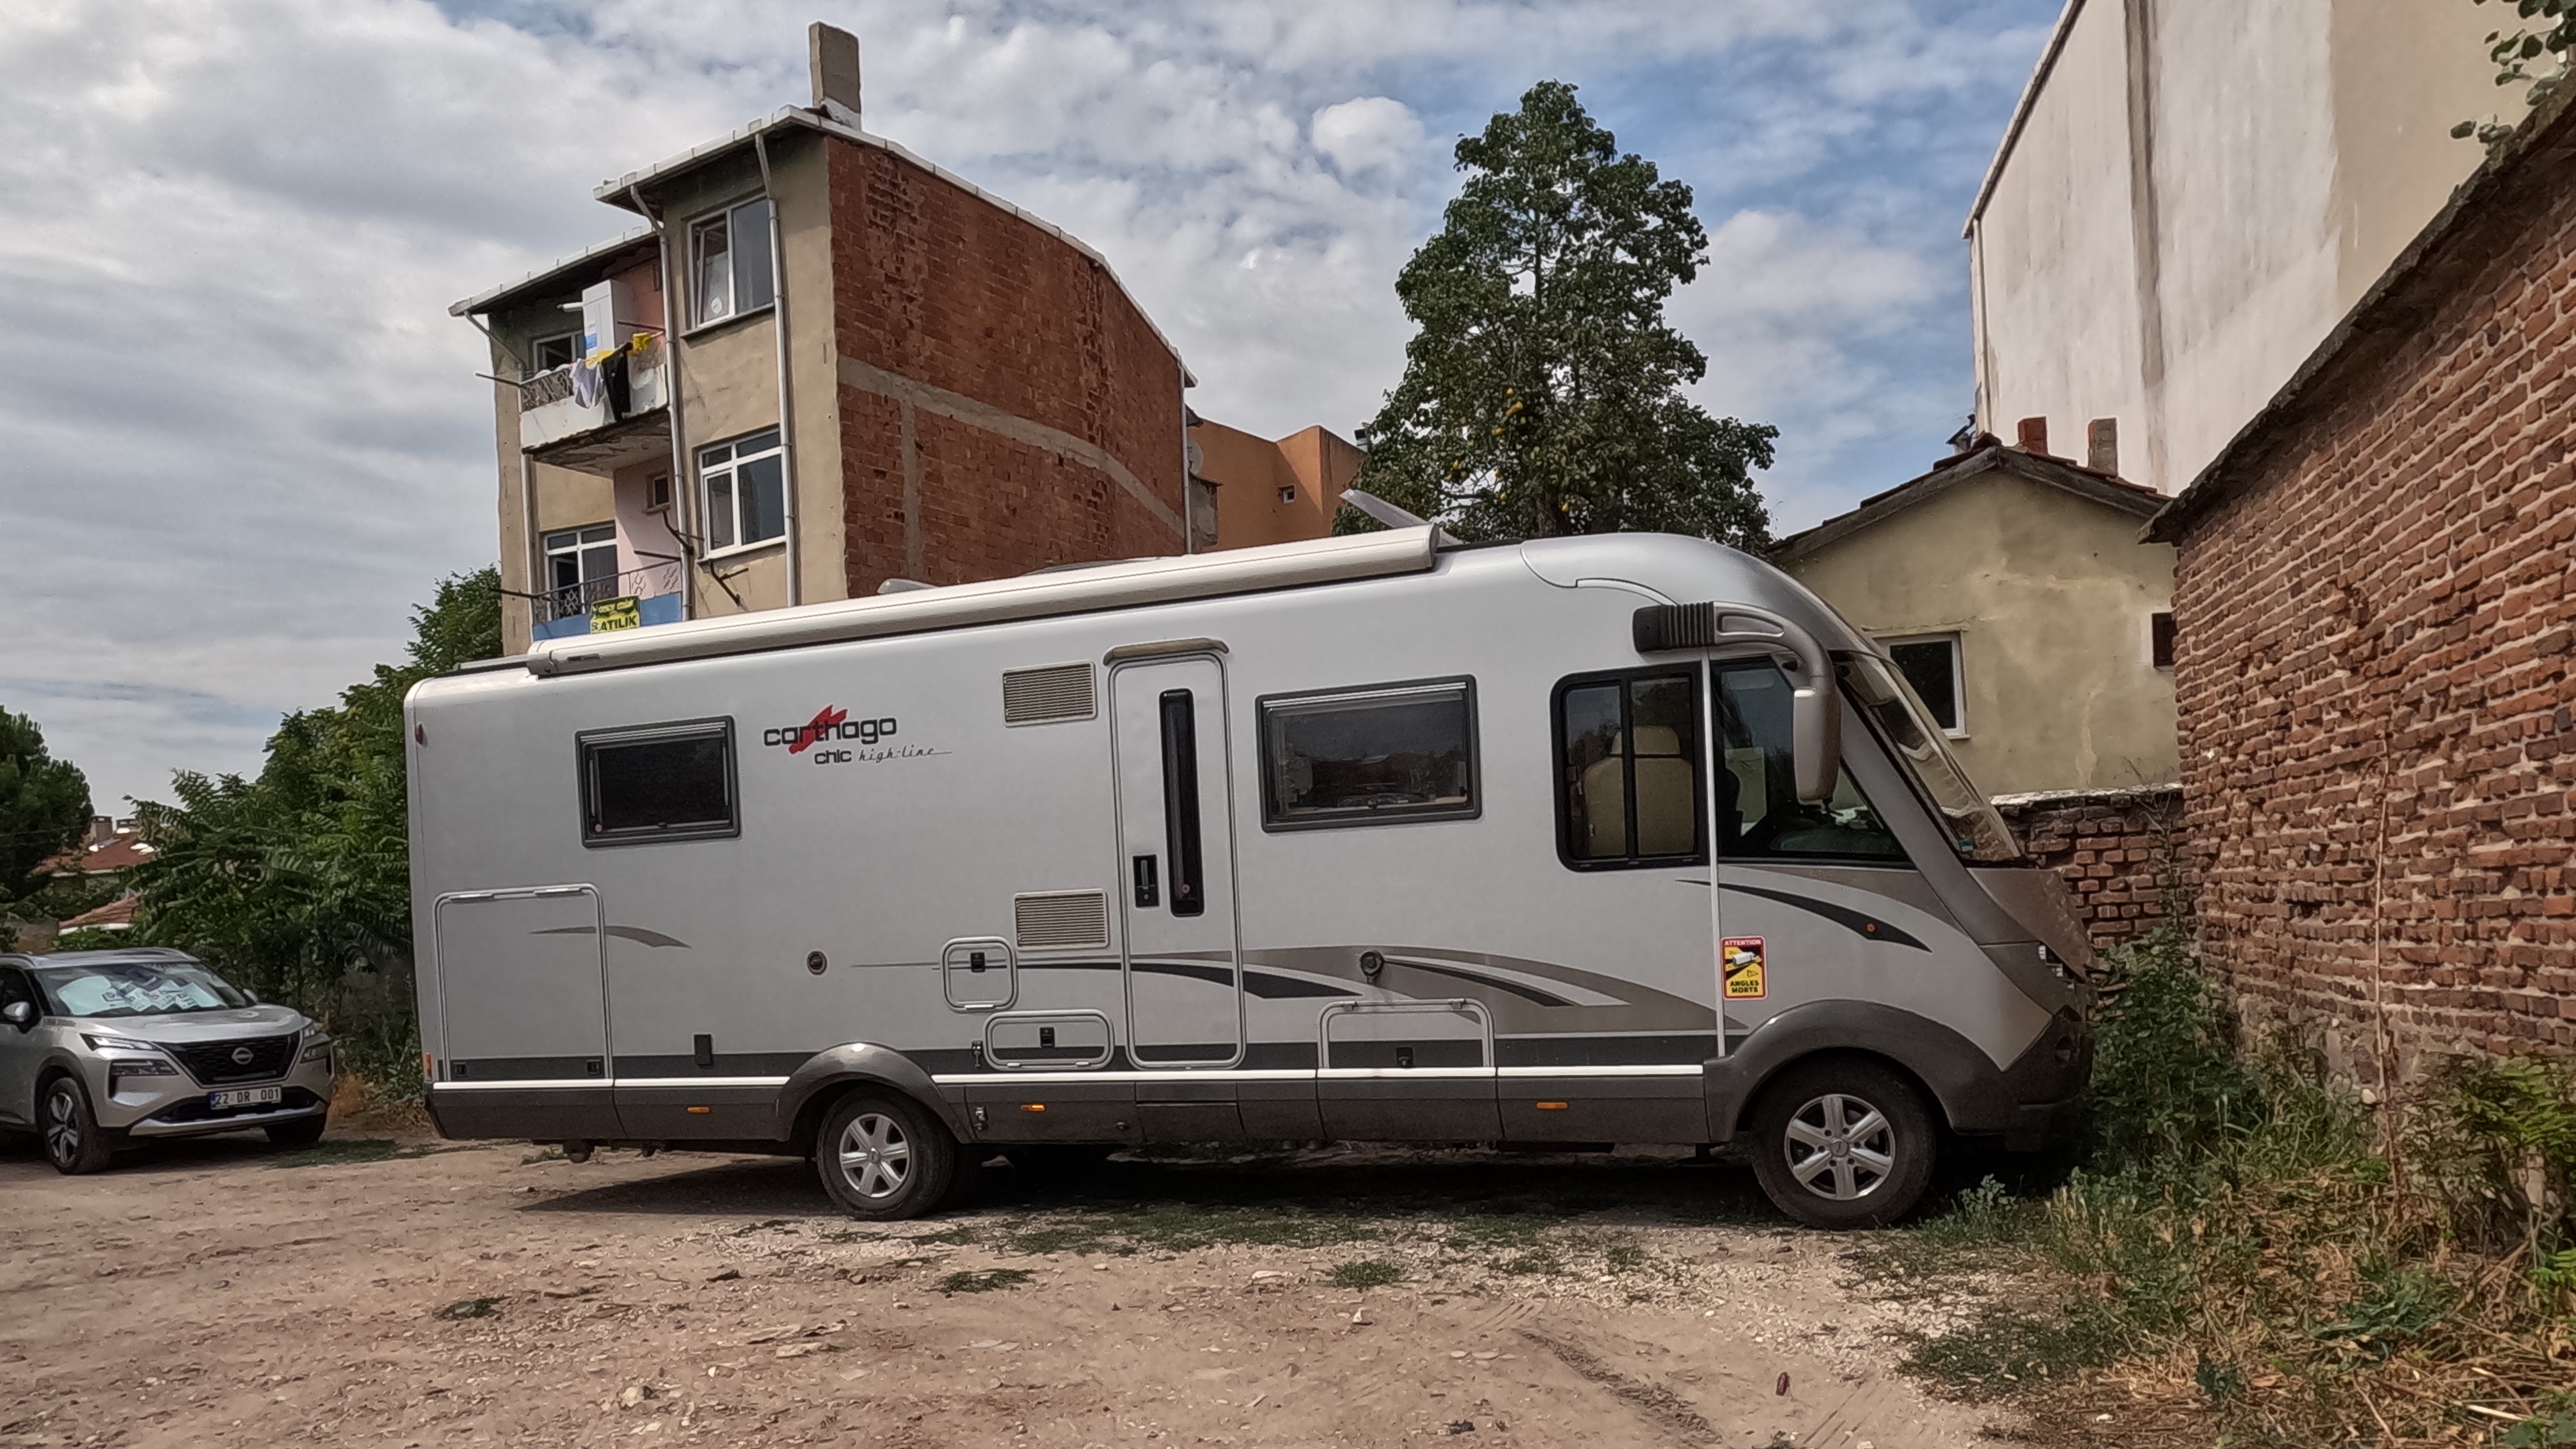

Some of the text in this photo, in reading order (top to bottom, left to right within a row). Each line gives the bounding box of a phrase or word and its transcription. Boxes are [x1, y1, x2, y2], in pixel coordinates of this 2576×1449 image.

[591, 615, 637, 631] SATILIK
[764, 718, 897, 746] carthago
[814, 744, 953, 764] chic high-line
[216, 1089, 279, 1105] 22 DR 001
